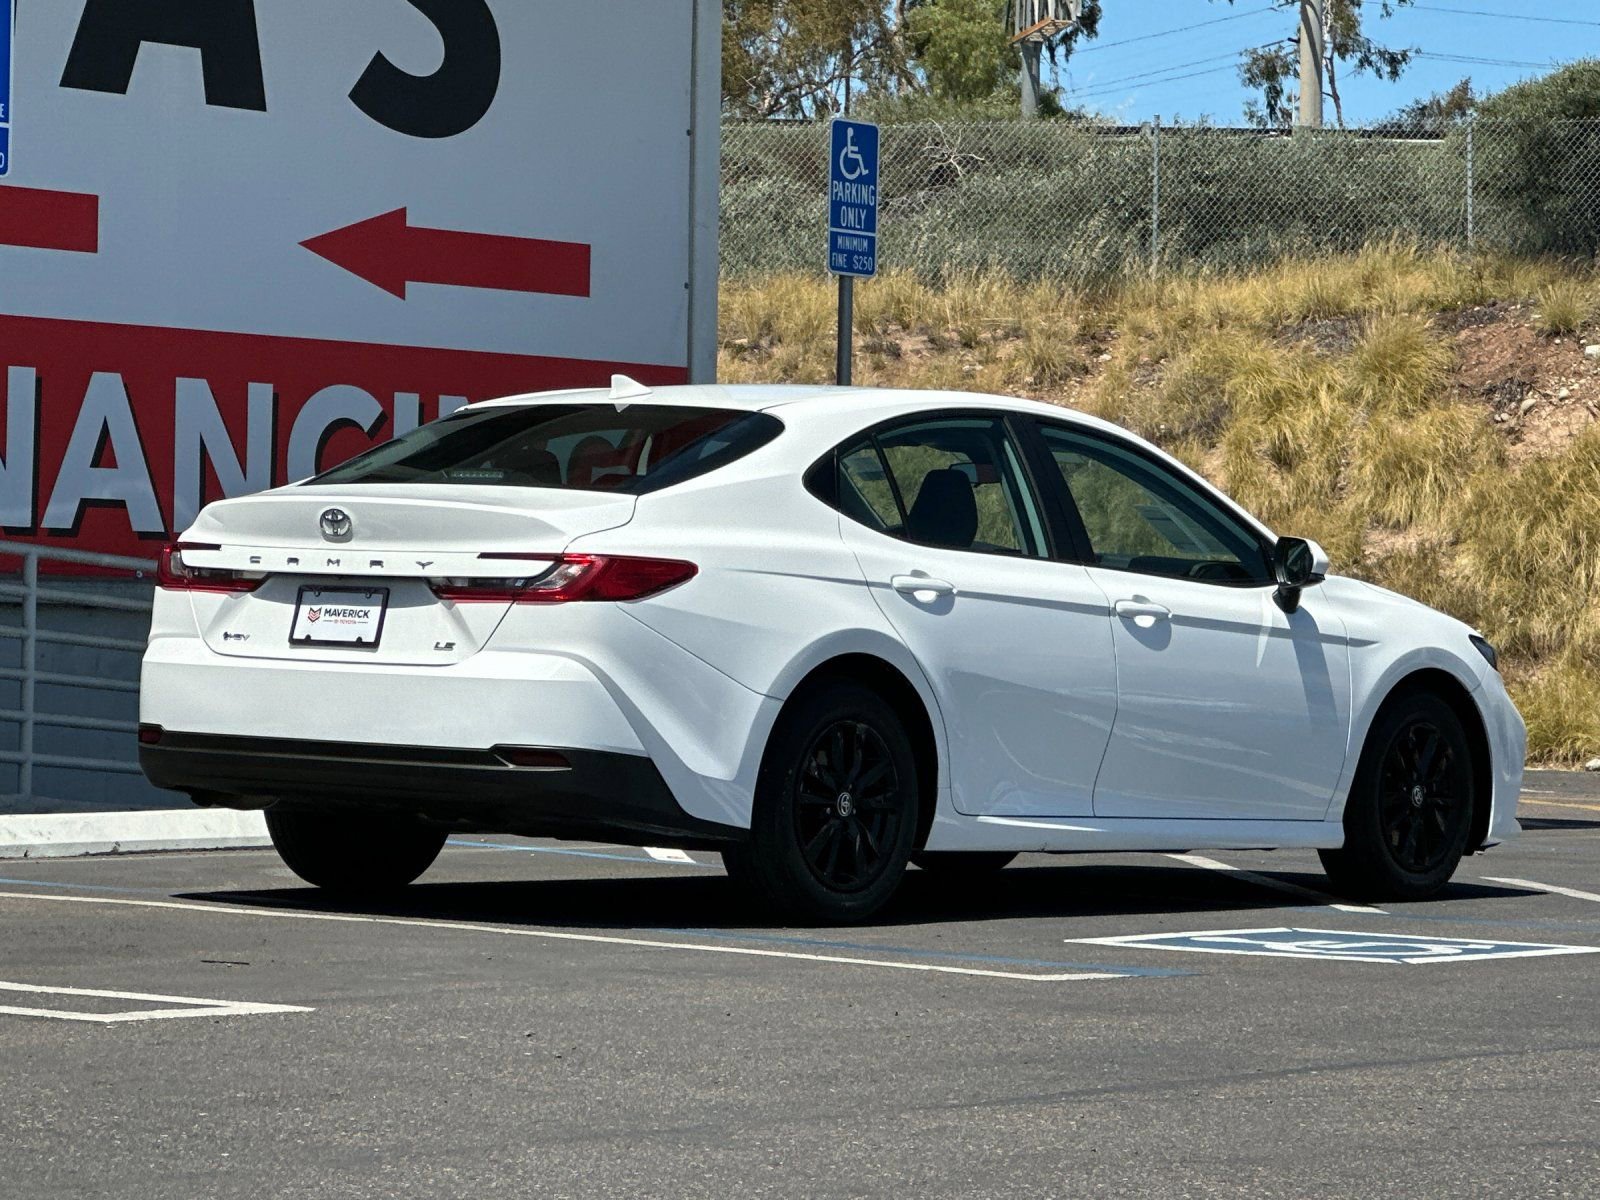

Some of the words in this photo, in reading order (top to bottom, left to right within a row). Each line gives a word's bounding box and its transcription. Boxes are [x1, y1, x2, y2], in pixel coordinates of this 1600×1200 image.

[833, 181, 875, 206] PARKING
[841, 207, 866, 229] ONLY
[837, 236, 868, 251] MINIMUM
[832, 253, 848, 268] FINE
[852, 255, 873, 271] $250
[249, 555, 434, 569] CAMRY
[323, 608, 371, 619] MAVERICK
